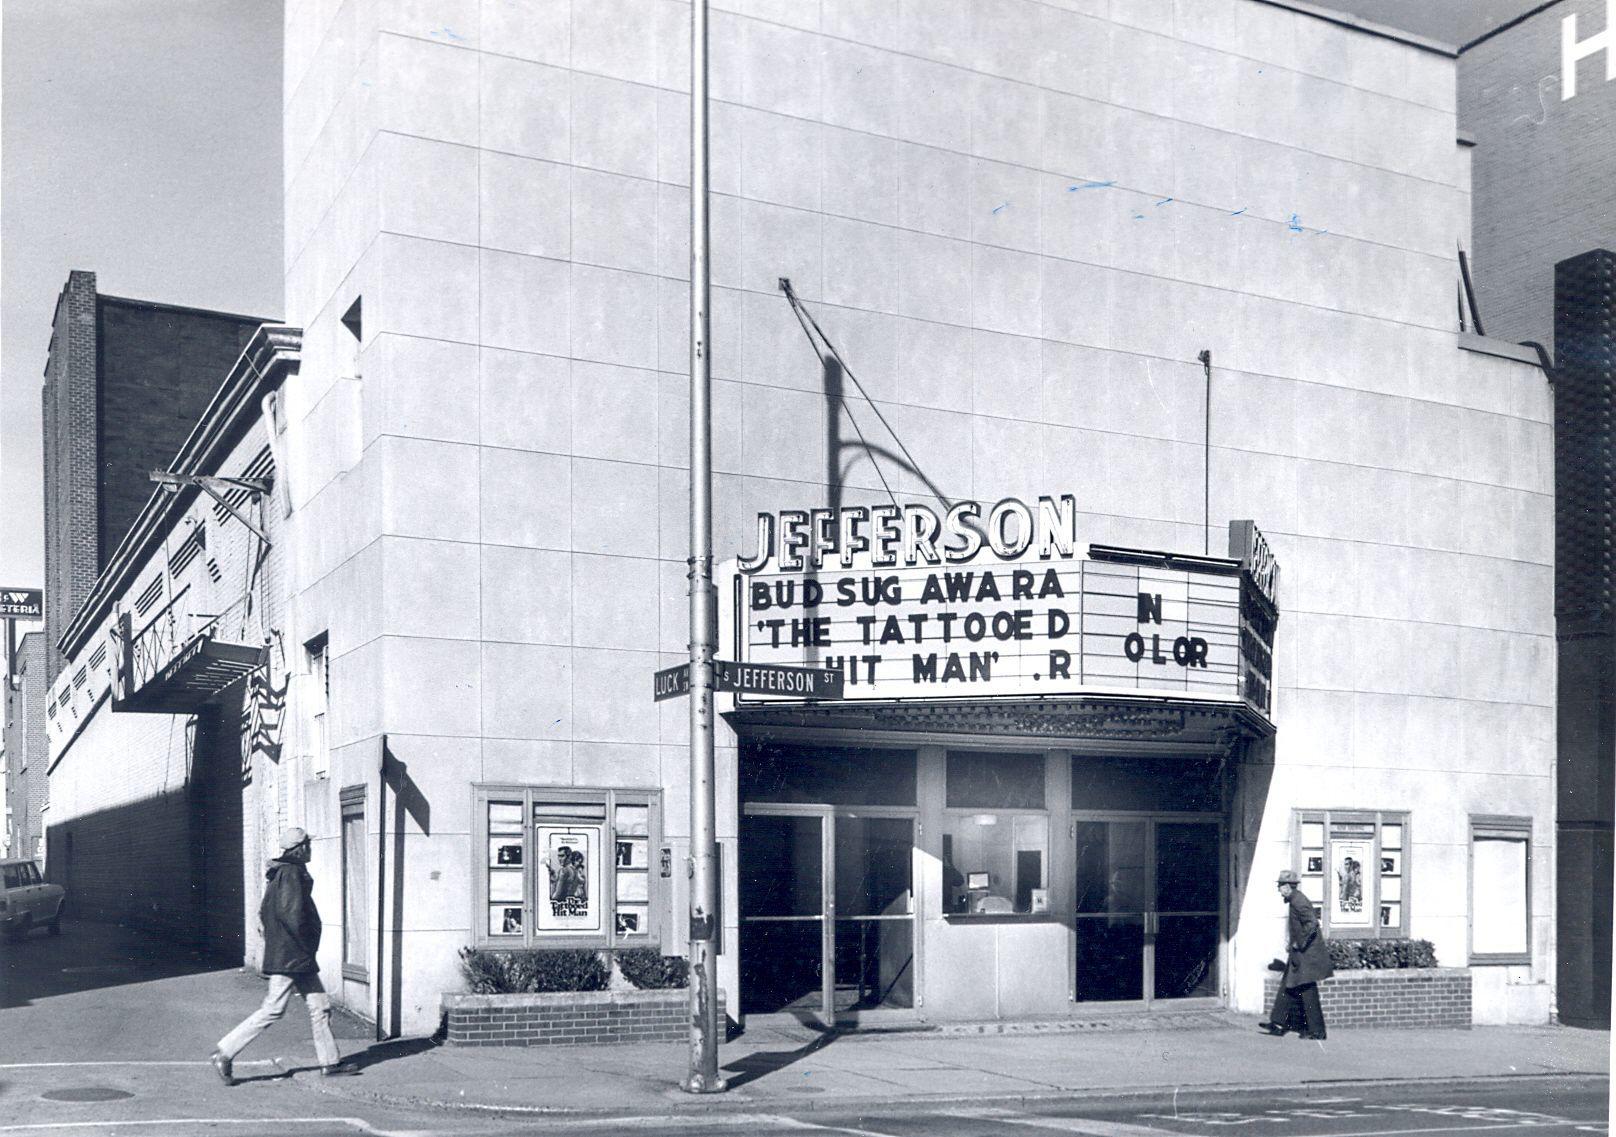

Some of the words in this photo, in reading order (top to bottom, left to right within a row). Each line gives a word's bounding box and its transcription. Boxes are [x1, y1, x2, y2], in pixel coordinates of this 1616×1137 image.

[737, 494, 1076, 575] JEFFERSON
[752, 579, 823, 611] BUD
[857, 608, 1070, 646] TATTOOED
[1124, 632, 1208, 668] OLOR
[655, 672, 679, 696] LUCK
[723, 671, 729, 682] S
[733, 667, 814, 692] JEFFERSON
[824, 672, 834, 684] ST
